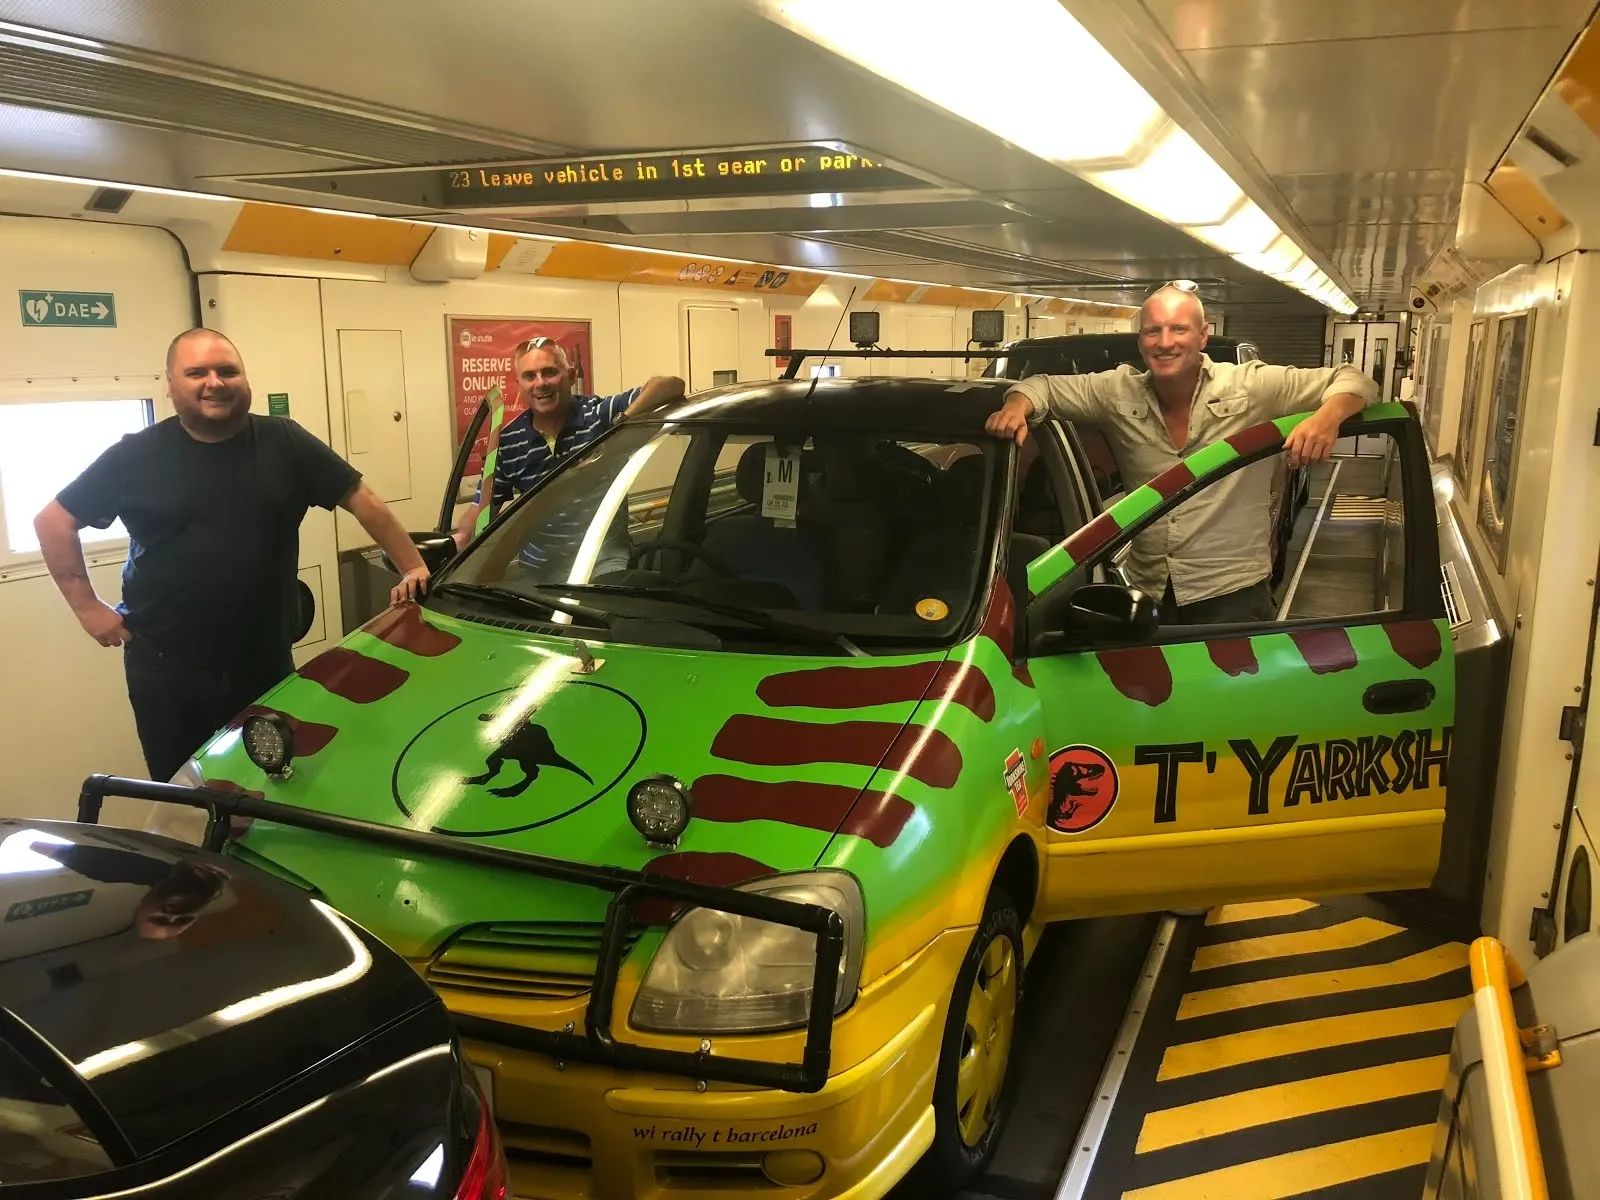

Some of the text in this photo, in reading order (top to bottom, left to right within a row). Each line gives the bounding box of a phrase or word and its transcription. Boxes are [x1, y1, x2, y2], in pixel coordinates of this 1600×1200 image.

[480, 169, 534, 187] leave
[544, 162, 624, 184] vehicle
[637, 160, 658, 180] in
[671, 157, 706, 178] 1st
[717, 158, 768, 177] gear
[780, 155, 807, 173] or
[54, 302, 90, 318] DAE
[462, 358, 511, 372] RESERVE
[463, 376, 506, 391] ONLINE
[463, 395, 477, 404] AND
[463, 406, 478, 416] OUR
[778, 460, 792, 483] M
[632, 1121, 818, 1148] wi rally t barcelona
